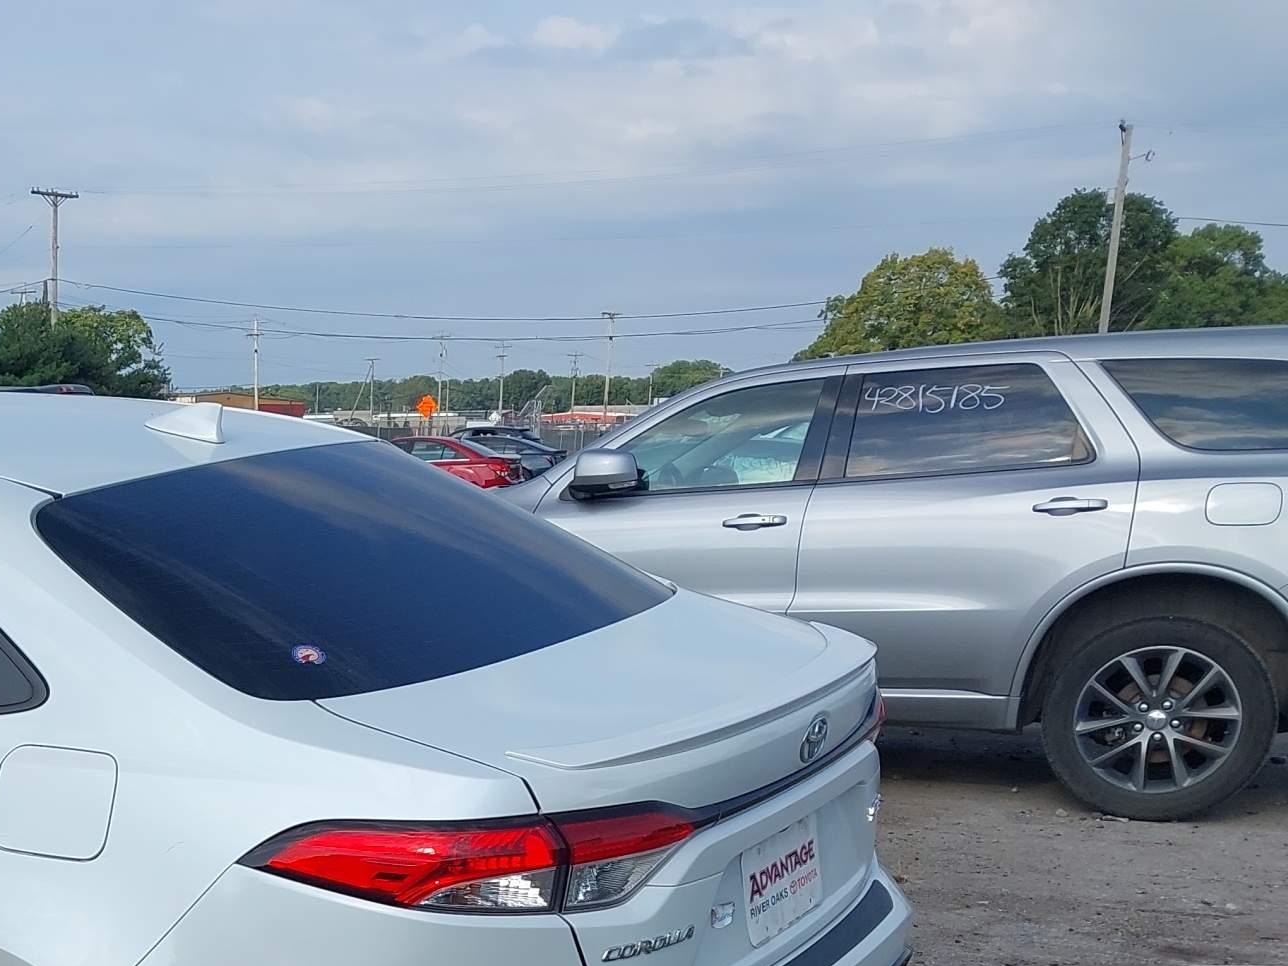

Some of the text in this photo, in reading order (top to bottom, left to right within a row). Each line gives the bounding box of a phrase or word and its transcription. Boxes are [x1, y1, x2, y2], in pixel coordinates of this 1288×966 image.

[864, 384, 1010, 413] 42815185
[749, 838, 815, 904] ADVANTAGE
[750, 899, 770, 920] RIVER
[770, 887, 789, 906] OAKS
[601, 926, 695, 962] COROLLA
